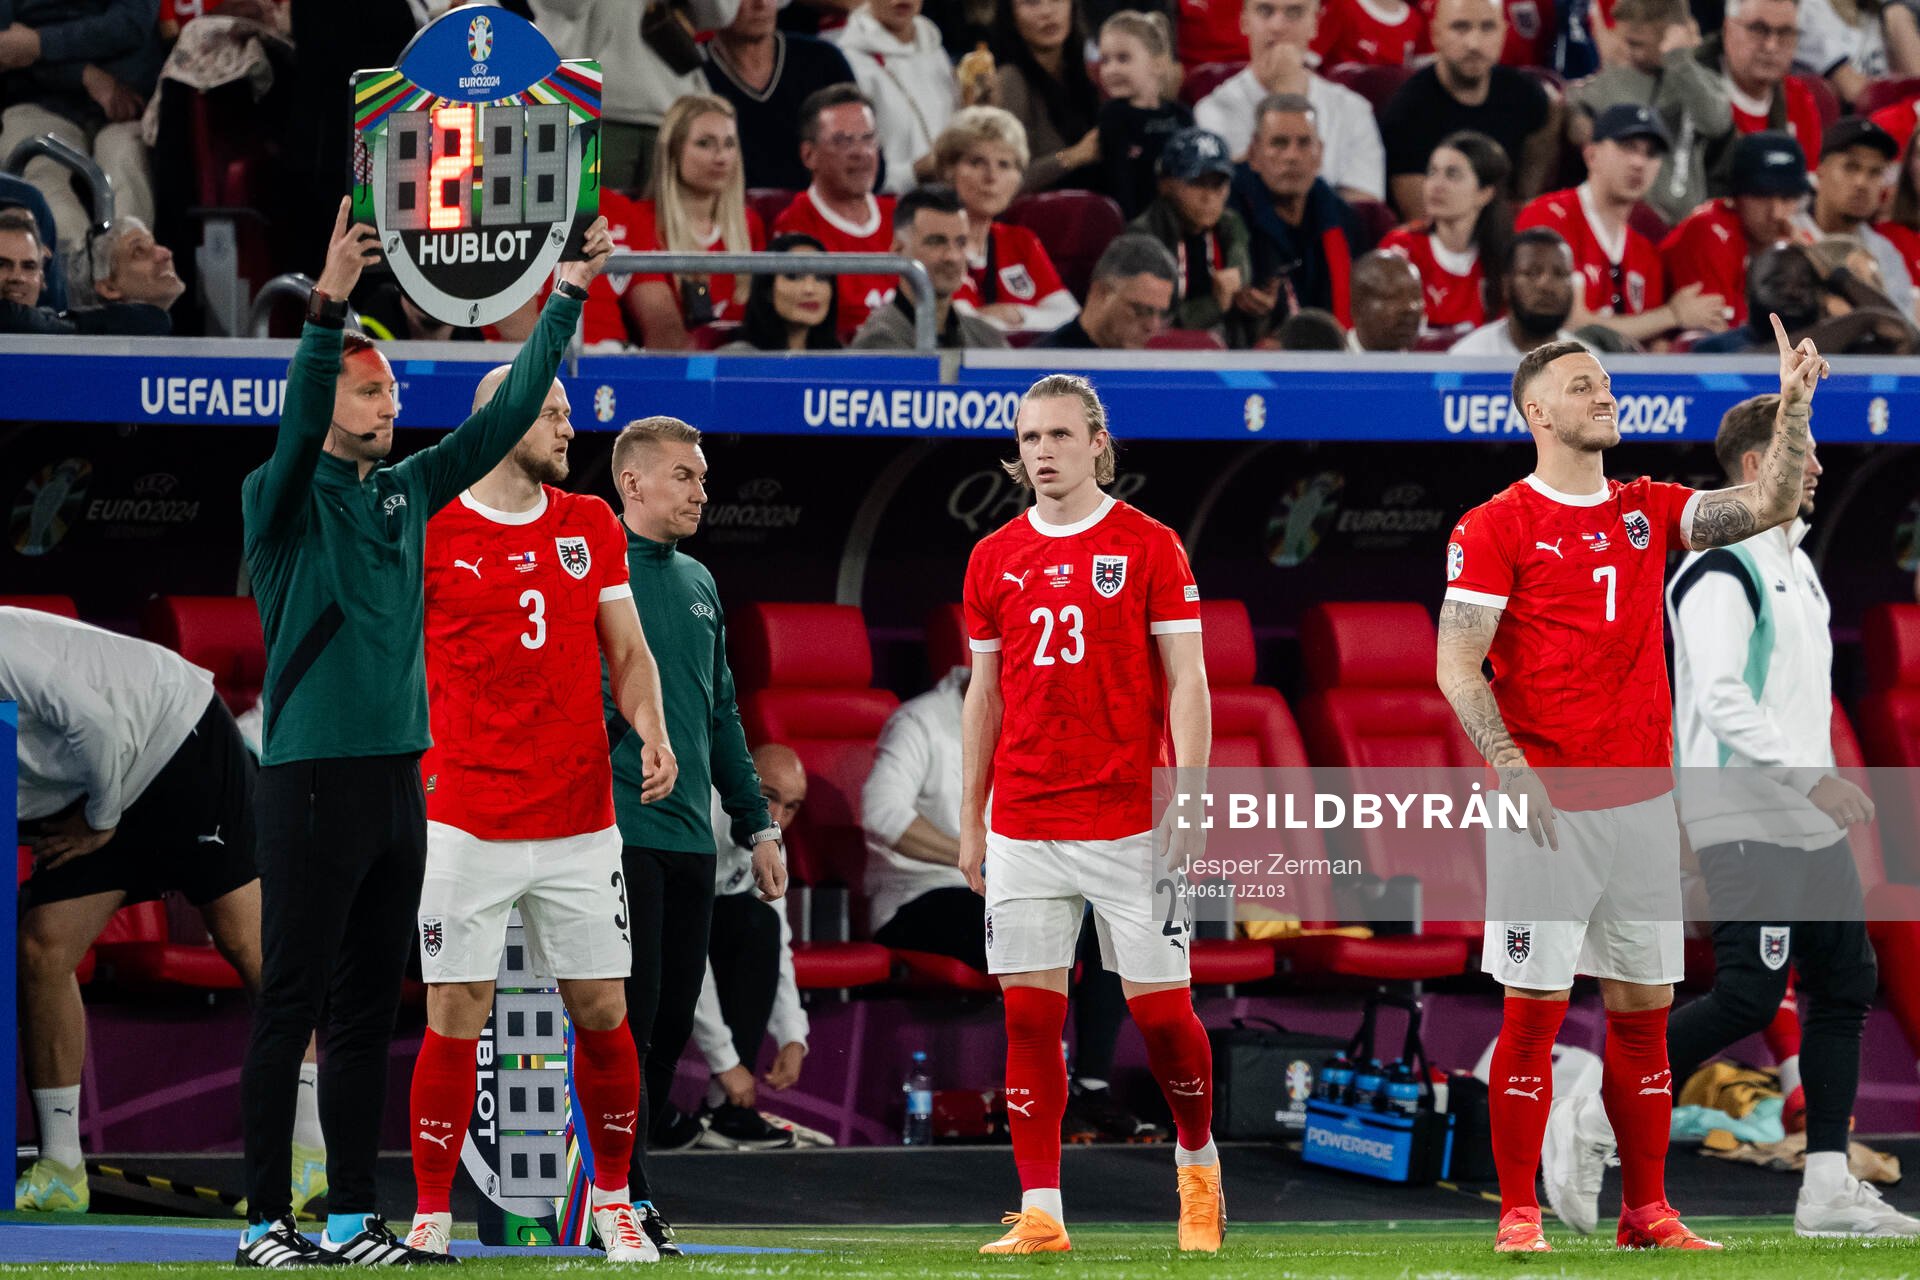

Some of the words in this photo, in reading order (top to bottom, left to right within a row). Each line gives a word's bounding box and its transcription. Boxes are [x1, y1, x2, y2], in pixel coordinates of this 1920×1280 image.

[459, 76, 500, 89] EURO2024
[429, 107, 475, 230] 2
[419, 230, 532, 266] HUBLOT
[141, 377, 288, 417] UEFAEU
[803, 388, 1020, 430] UEFAEURO20
[86, 499, 200, 523] EURO2024
[706, 504, 802, 528] URO2024
[1593, 566, 1617, 622] 7
[519, 589, 547, 650] 3
[1030, 605, 1085, 666] 23
[476, 1009, 496, 1145] BLOT
[1307, 1127, 1395, 1162] POWERADE
